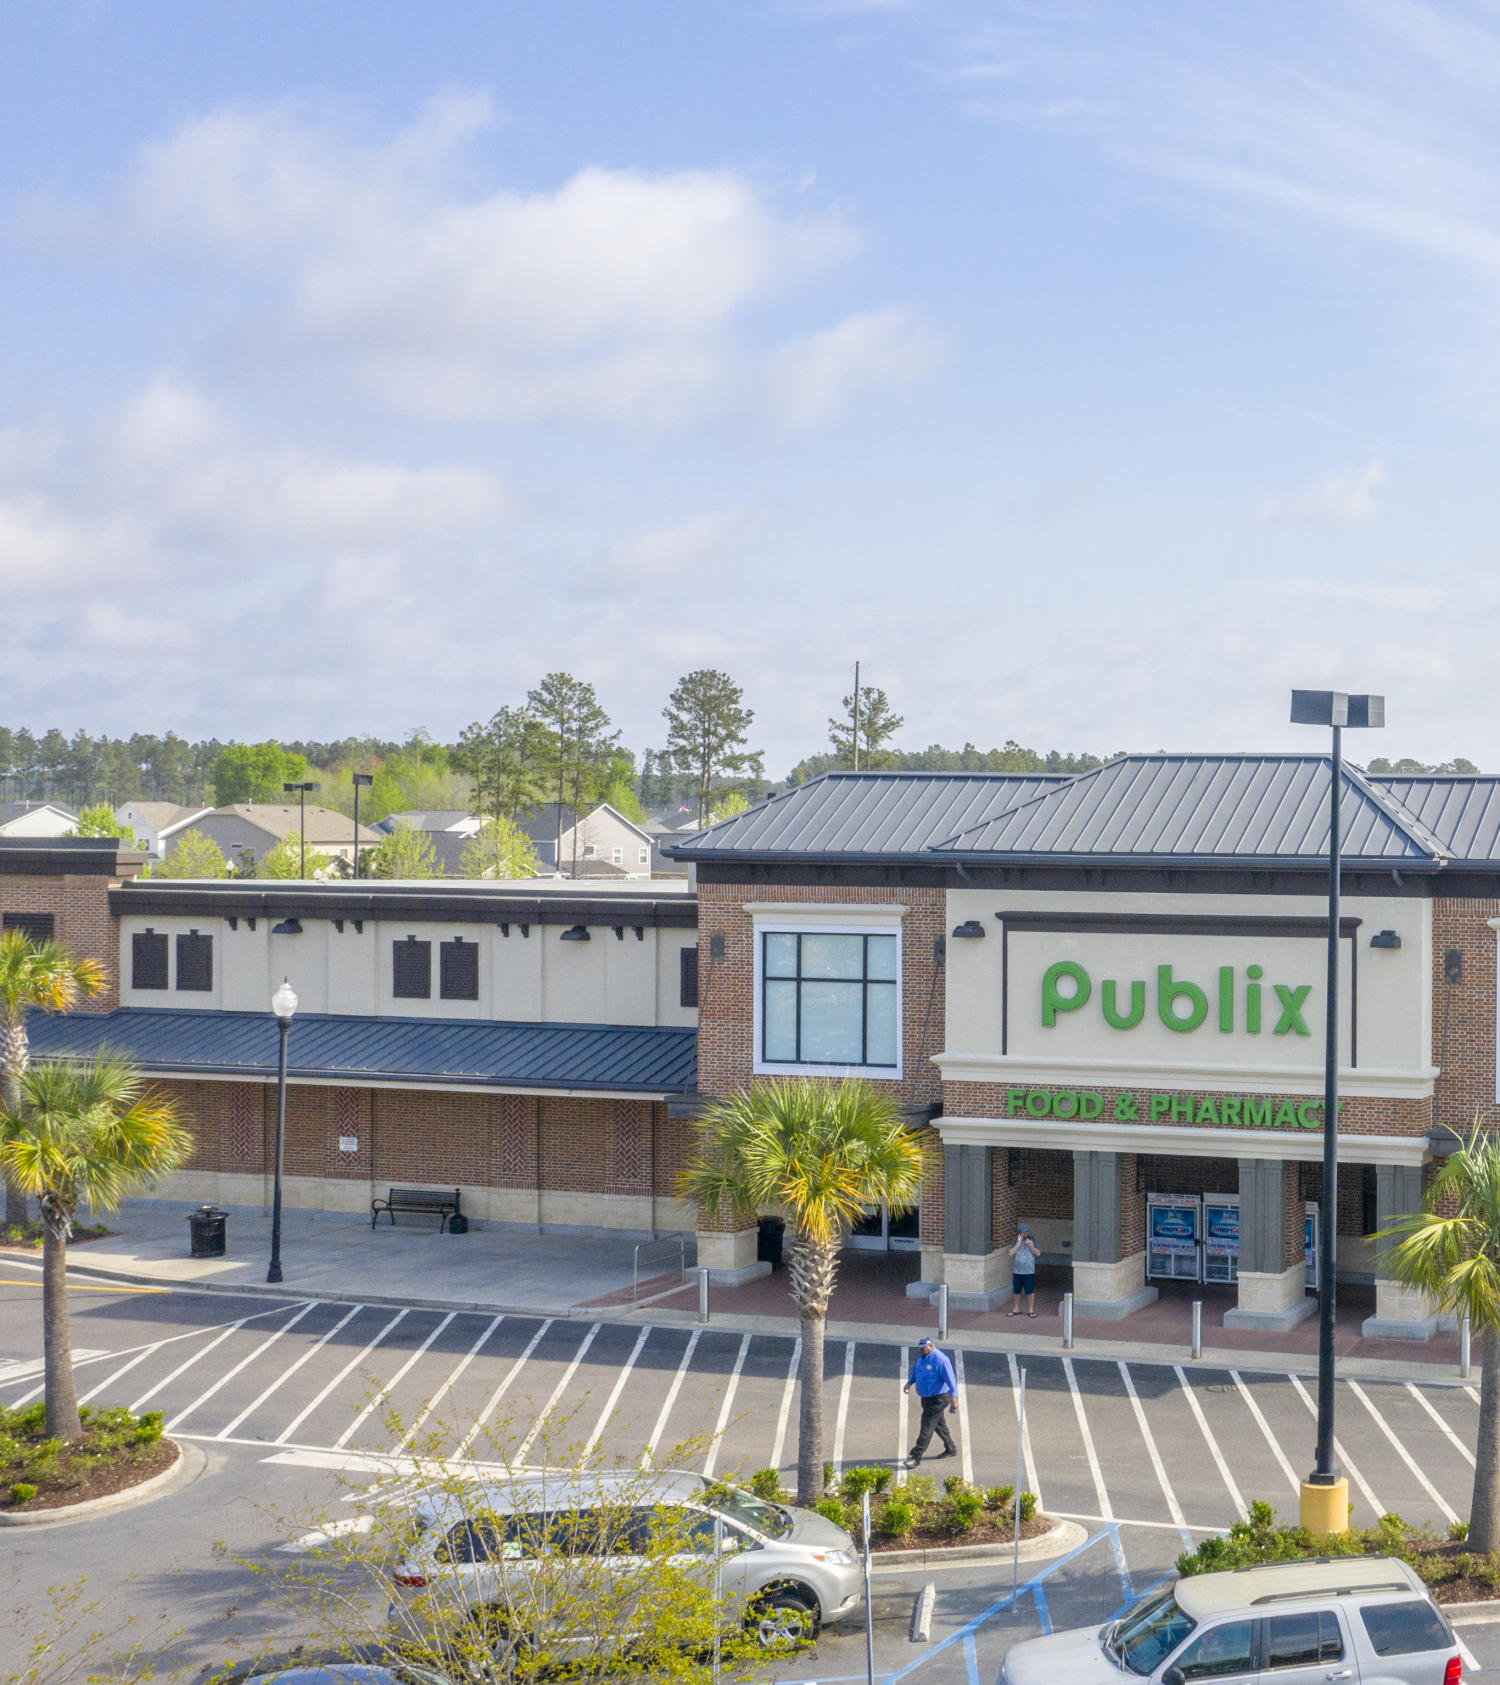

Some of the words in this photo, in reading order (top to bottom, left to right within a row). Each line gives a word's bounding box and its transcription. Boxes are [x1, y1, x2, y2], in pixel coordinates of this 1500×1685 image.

[1041, 960, 1312, 1037] Publix
[1007, 1089, 1105, 1120] FOOD
[1113, 1093, 1139, 1121] &
